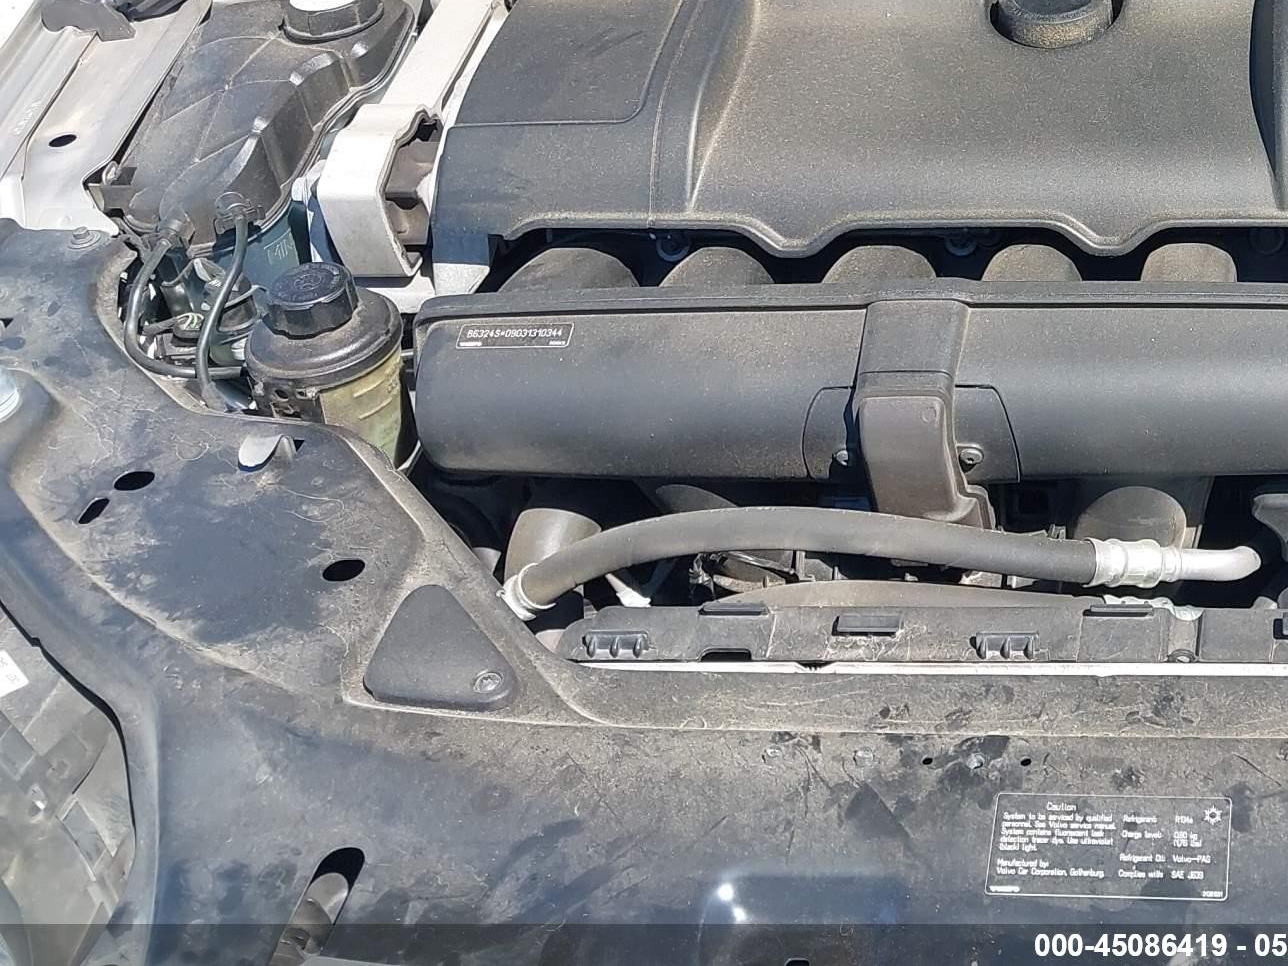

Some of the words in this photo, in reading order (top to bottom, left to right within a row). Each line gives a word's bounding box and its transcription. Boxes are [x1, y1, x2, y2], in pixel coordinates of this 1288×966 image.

[1046, 801, 1077, 812] Caution
[1003, 812, 1026, 821] System
[1029, 812, 1036, 820] to
[1038, 812, 1046, 820] be
[1075, 813, 1083, 822] by
[1085, 812, 1113, 822] qualified
[1048, 821, 1068, 829] Volvo
[1001, 826, 1024, 836] System
[996, 866, 1016, 875] Volvo
[1018, 867, 1028, 875] Car
[1171, 870, 1184, 879] SAE
